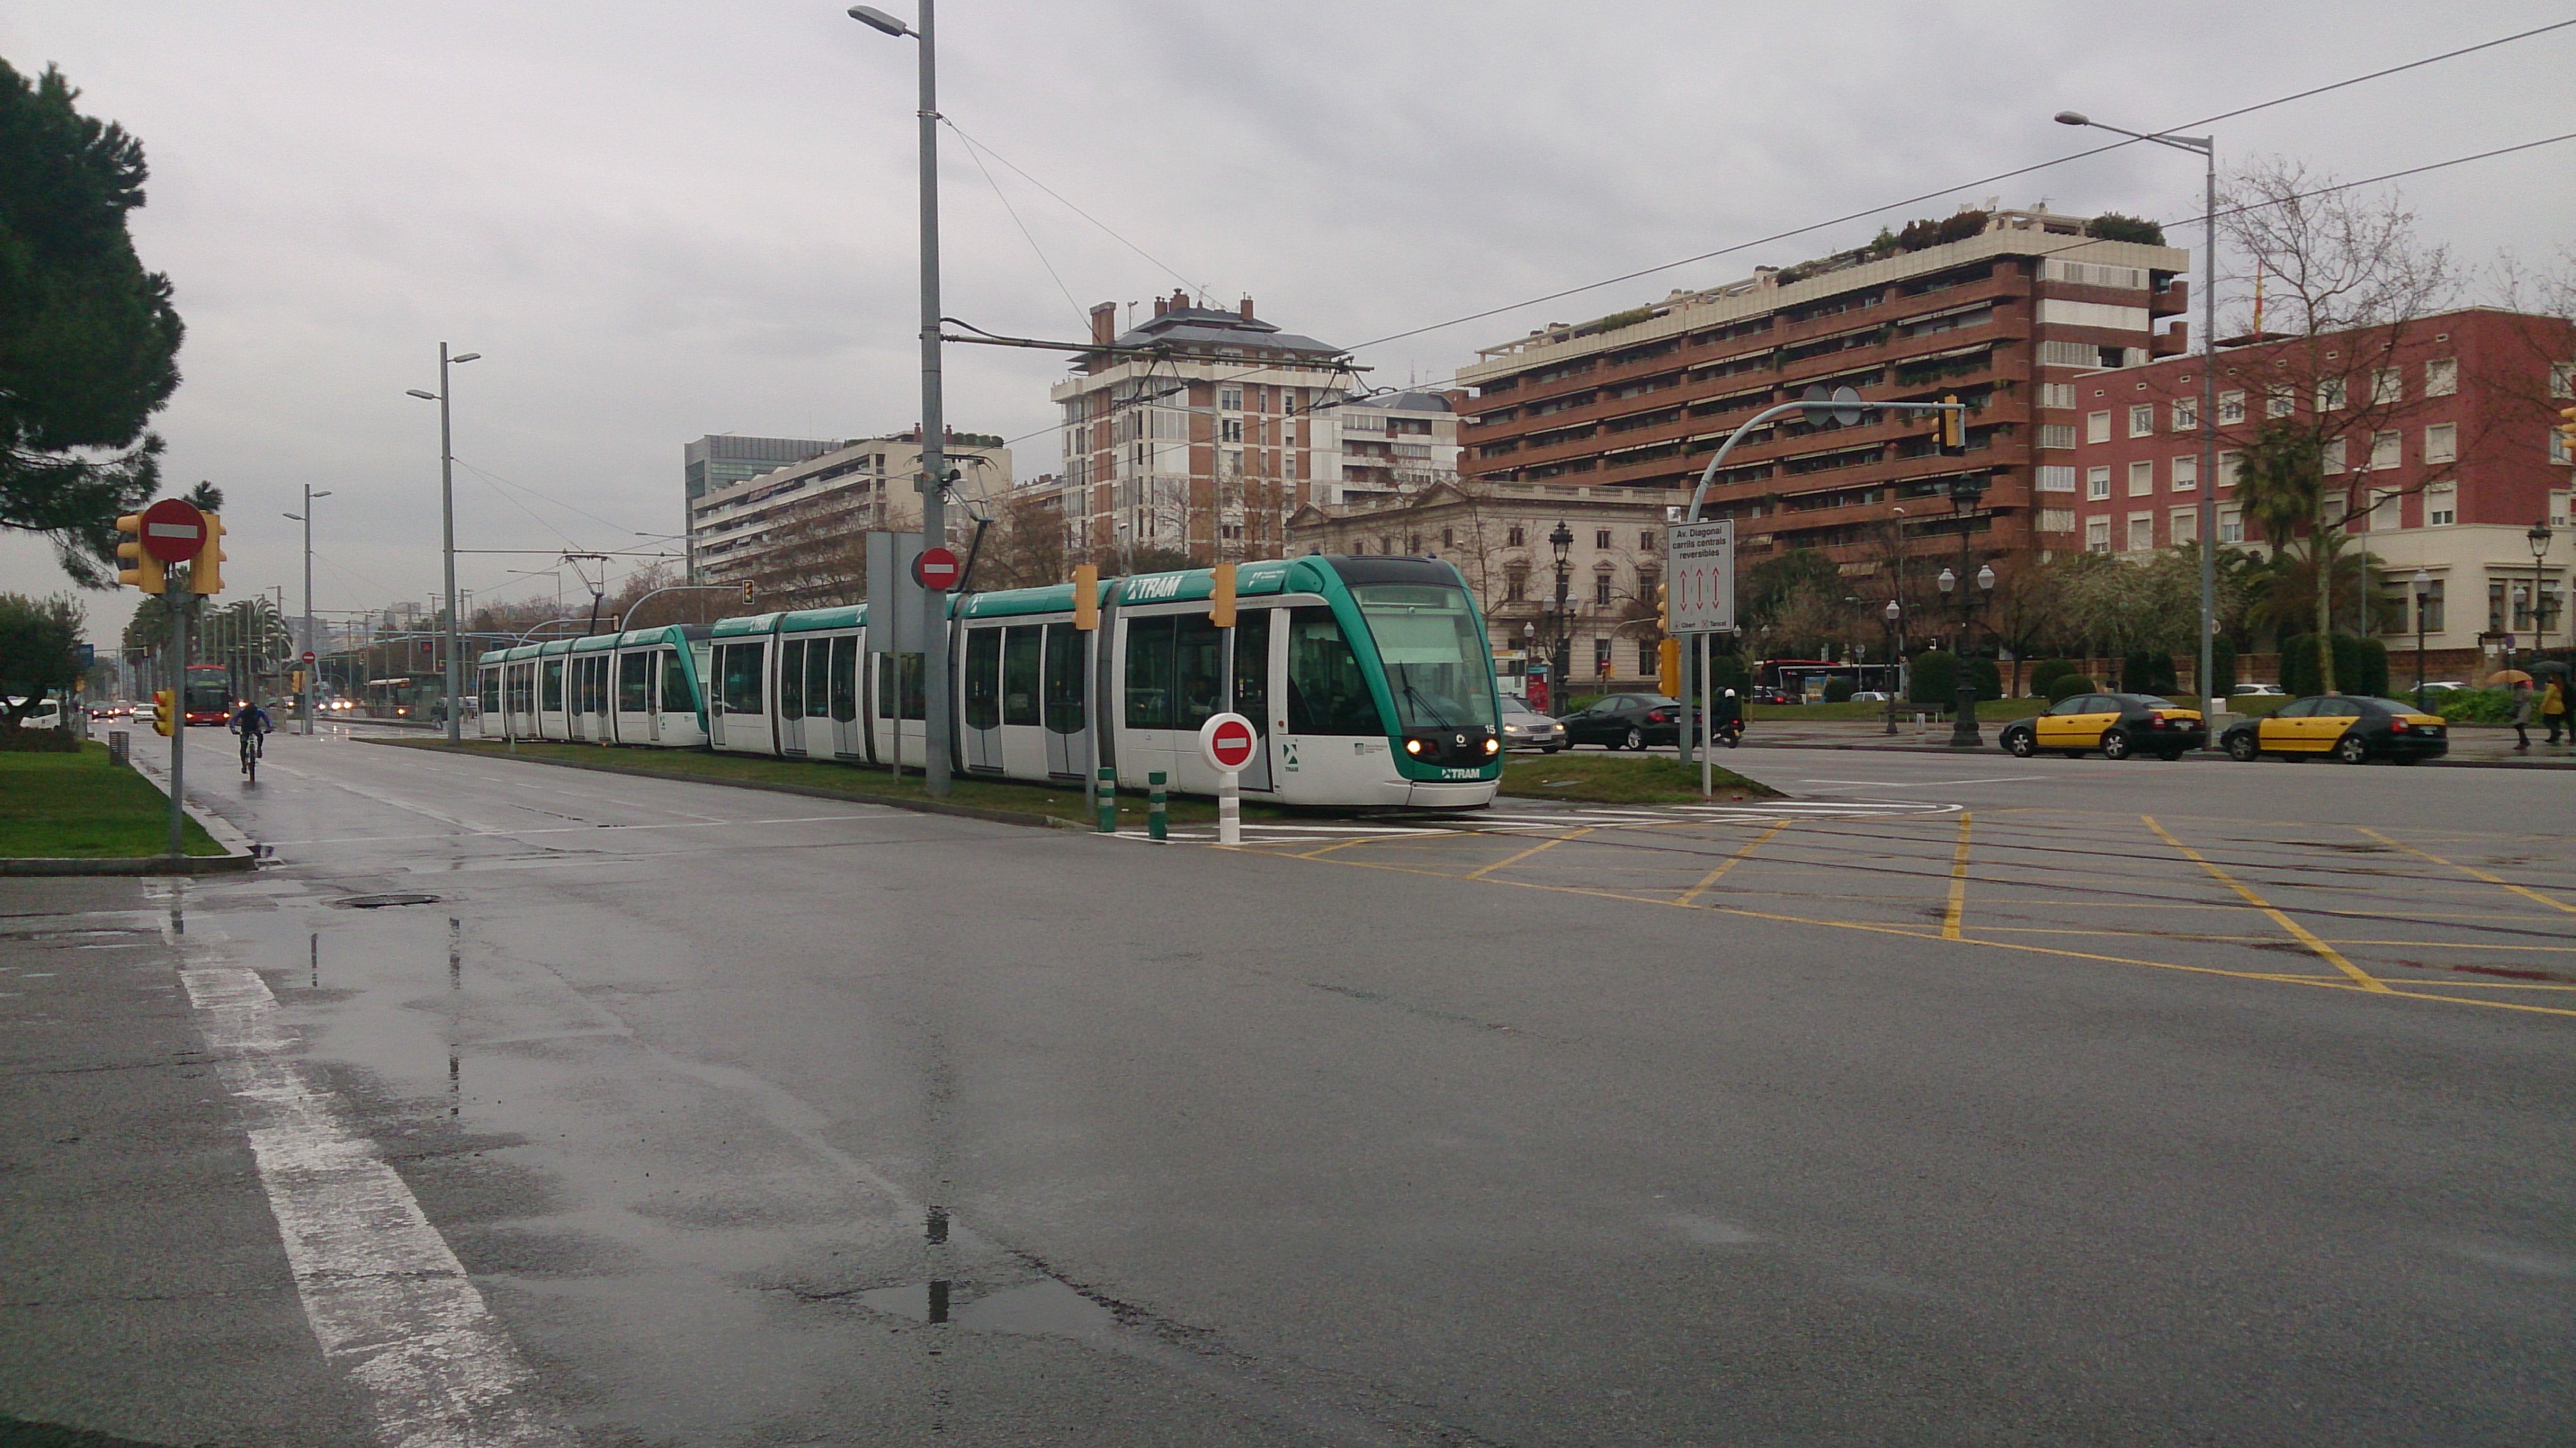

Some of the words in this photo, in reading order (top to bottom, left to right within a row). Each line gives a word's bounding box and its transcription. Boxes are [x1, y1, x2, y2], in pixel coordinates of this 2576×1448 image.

[1690, 526, 1722, 537] Diagonal
[1672, 540, 1695, 549] carrils
[1697, 537, 1726, 547] centrals
[1680, 549, 1719, 559] reversibles
[1138, 576, 1183, 599] TRAM
[1484, 724, 1496, 735] 15
[1451, 768, 1480, 779] TRAM
